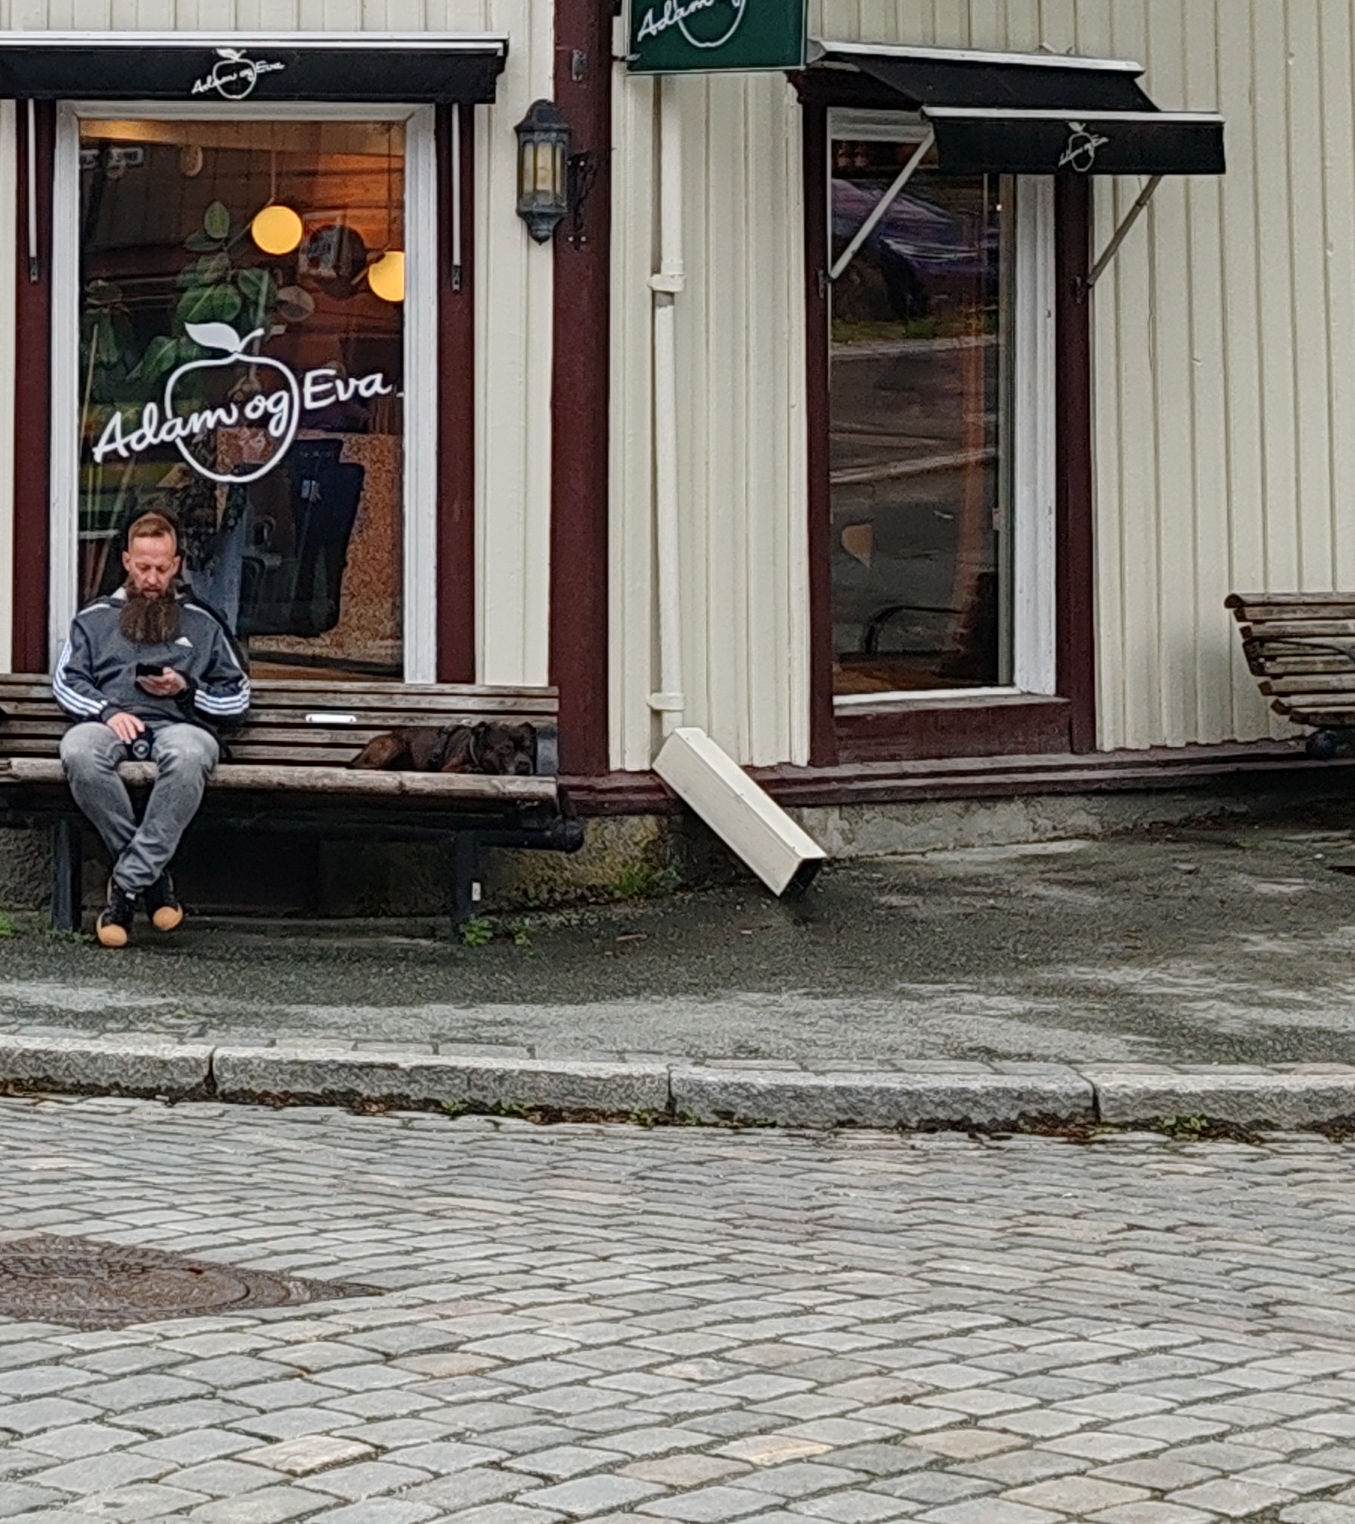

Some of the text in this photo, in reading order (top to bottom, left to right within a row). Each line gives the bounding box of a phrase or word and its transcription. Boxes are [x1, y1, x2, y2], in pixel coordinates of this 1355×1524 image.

[92, 369, 392, 464] Adam og Eva
